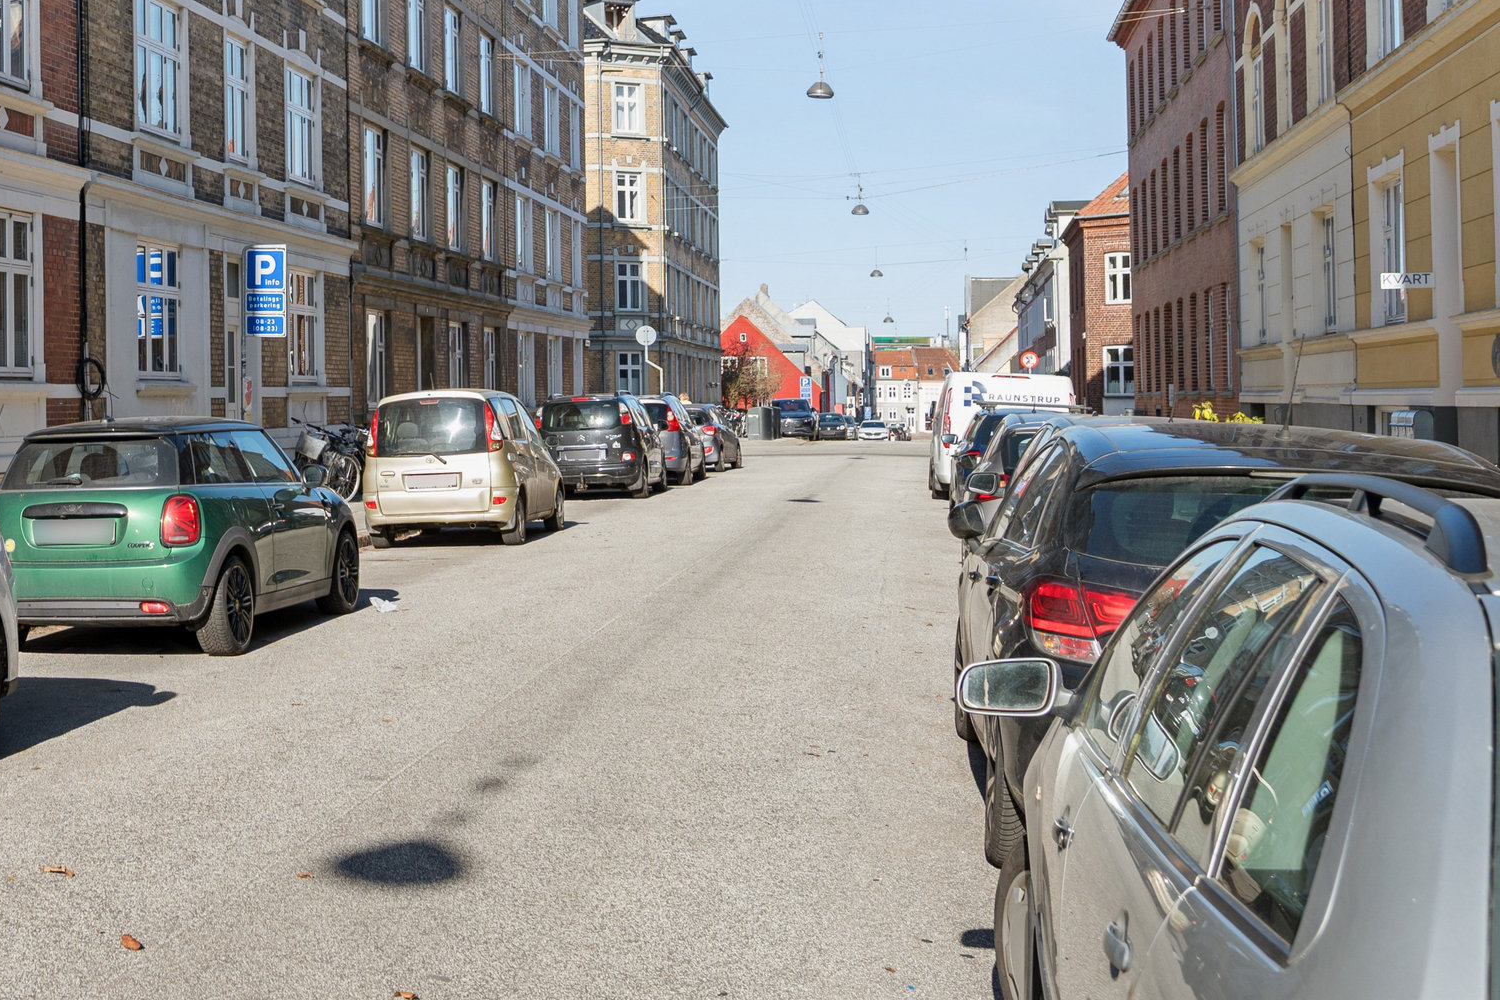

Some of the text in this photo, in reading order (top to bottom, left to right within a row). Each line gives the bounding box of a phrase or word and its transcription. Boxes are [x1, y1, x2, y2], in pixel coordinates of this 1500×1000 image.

[255, 254, 276, 286] P
[1382, 273, 1431, 284] KVART
[988, 394, 1061, 404] RAUNSTRUP
